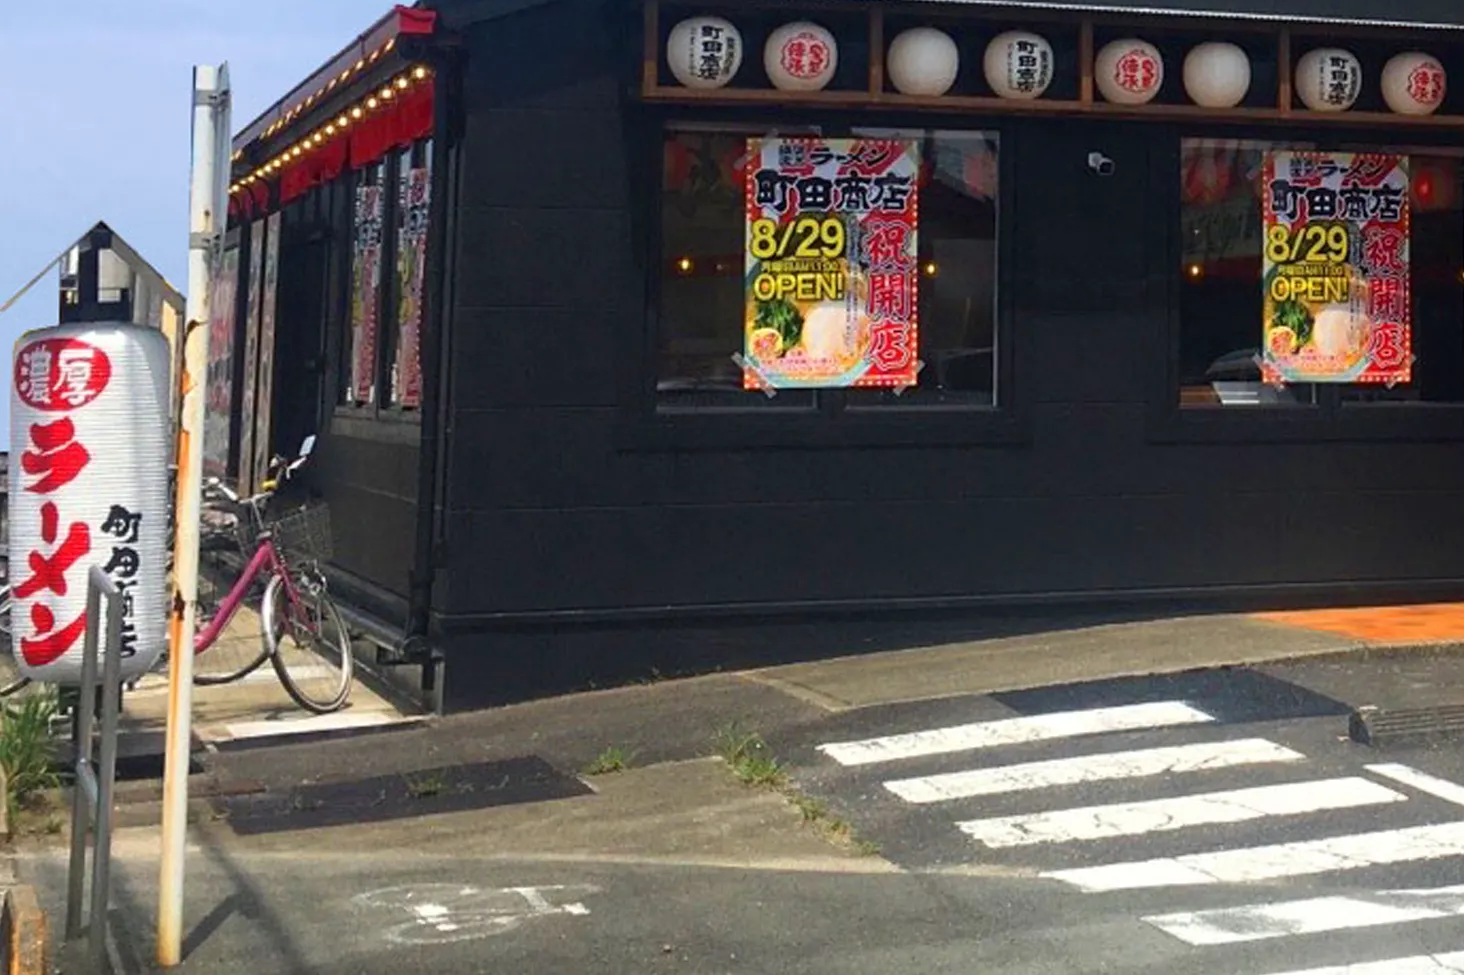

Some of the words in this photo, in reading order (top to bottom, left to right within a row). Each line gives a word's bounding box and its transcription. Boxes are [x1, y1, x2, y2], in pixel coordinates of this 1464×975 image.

[809, 146, 890, 166] ラーメン
[754, 169, 914, 214] 町田商店
[1269, 179, 1405, 222] 町田商店
[751, 218, 845, 259] 8/29
[1267, 225, 1348, 263] 8/29
[754, 274, 845, 301] OPEN!
[867, 224, 910, 368] 祝開店
[1271, 277, 1349, 302] OPEN!
[1366, 229, 1406, 367] 祝開店
[20, 344, 96, 406] 濃厚
[12, 417, 92, 667] ラーメン
